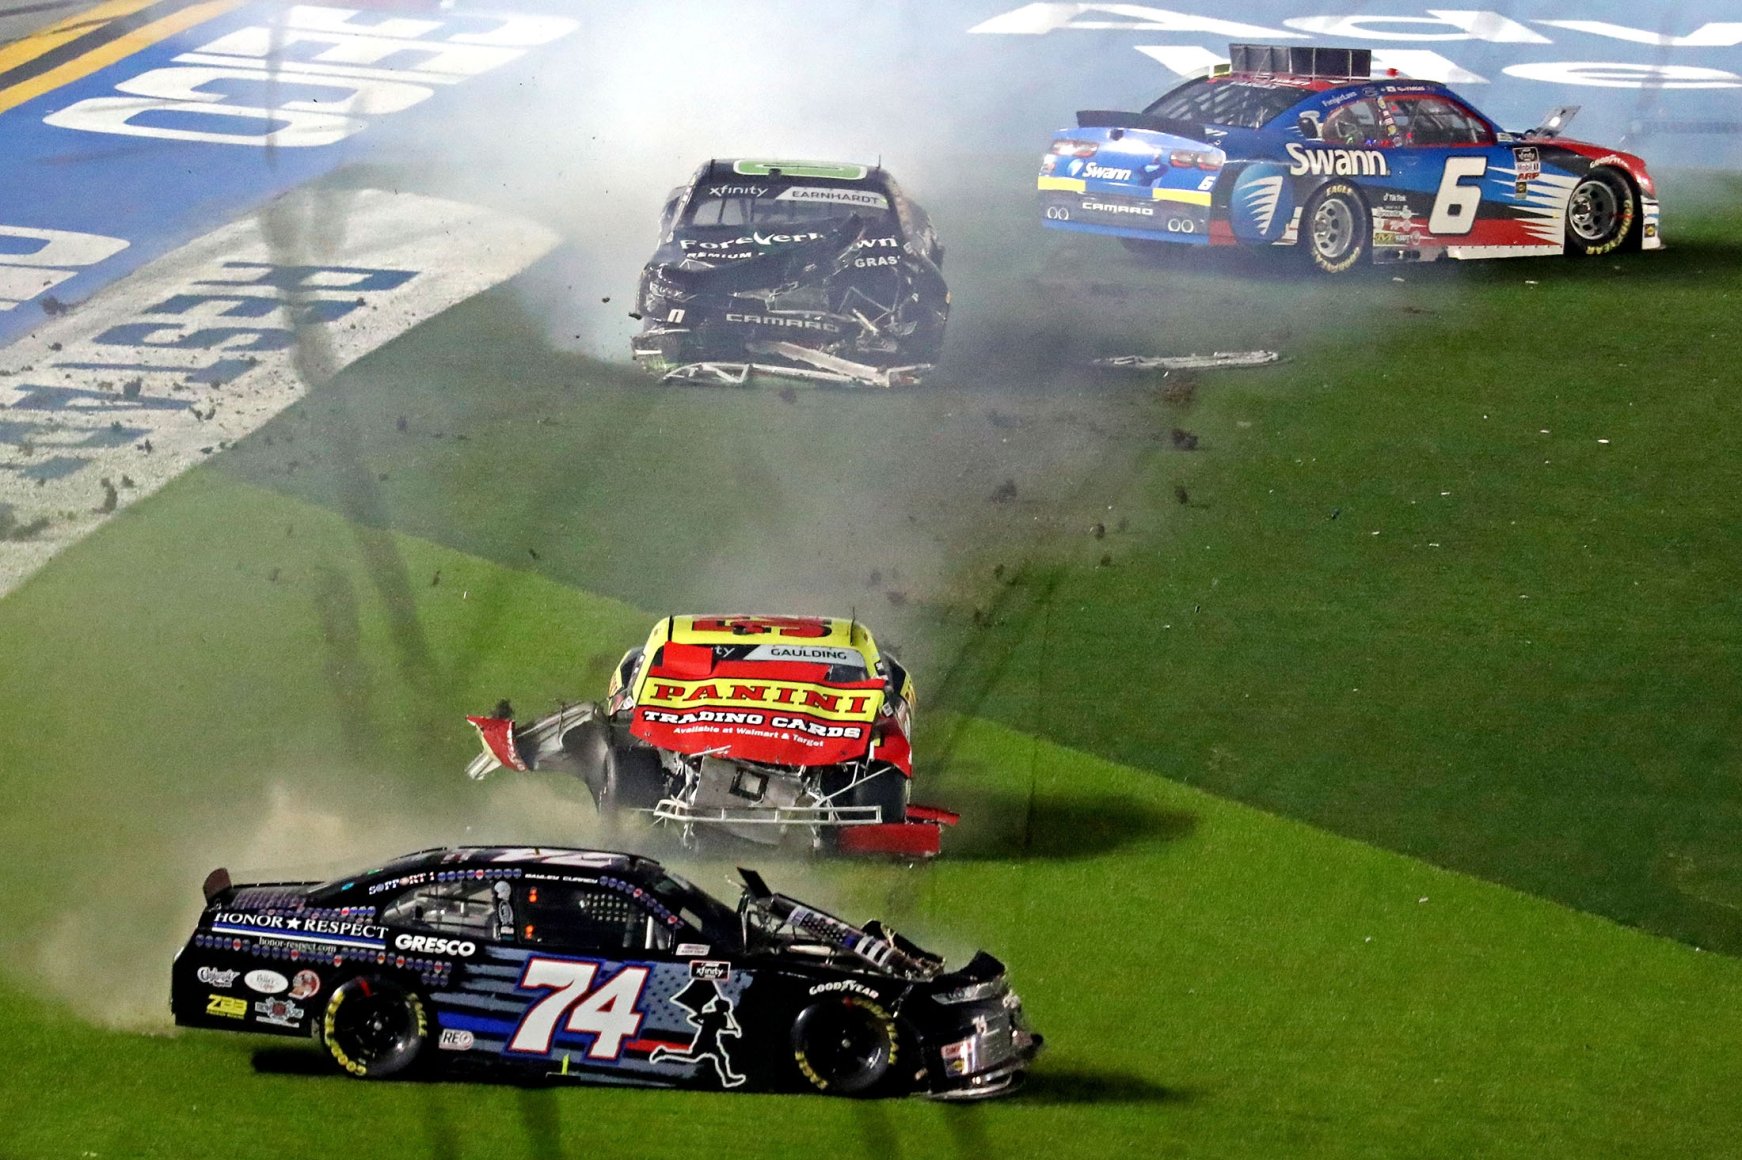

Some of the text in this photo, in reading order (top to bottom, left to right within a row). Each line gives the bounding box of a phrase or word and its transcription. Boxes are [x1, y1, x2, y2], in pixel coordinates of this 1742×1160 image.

[1286, 143, 1388, 176] Swann
[1081, 161, 1132, 181] Swann
[1517, 172, 1540, 180] ARP
[709, 184, 769, 198] xfinity
[1197, 175, 1216, 191] 6
[1326, 184, 1353, 197] EAGLE
[792, 191, 879, 205] EARNHARDT
[1428, 156, 1487, 235] 6
[1082, 202, 1154, 216] CAMARO
[726, 313, 839, 333] CAMARO
[770, 648, 848, 660] GAULDING
[650, 683, 871, 714] PANINI
[643, 710, 861, 739] TRADING CARDS
[673, 726, 720, 735] Available
[736, 727, 780, 740] Walmart
[792, 734, 825, 748] Target
[213, 911, 390, 940] HONOR RESPECT
[394, 933, 476, 957] GRESCO
[808, 979, 880, 1000] GOODYEAR
[507, 957, 651, 1062] 74
